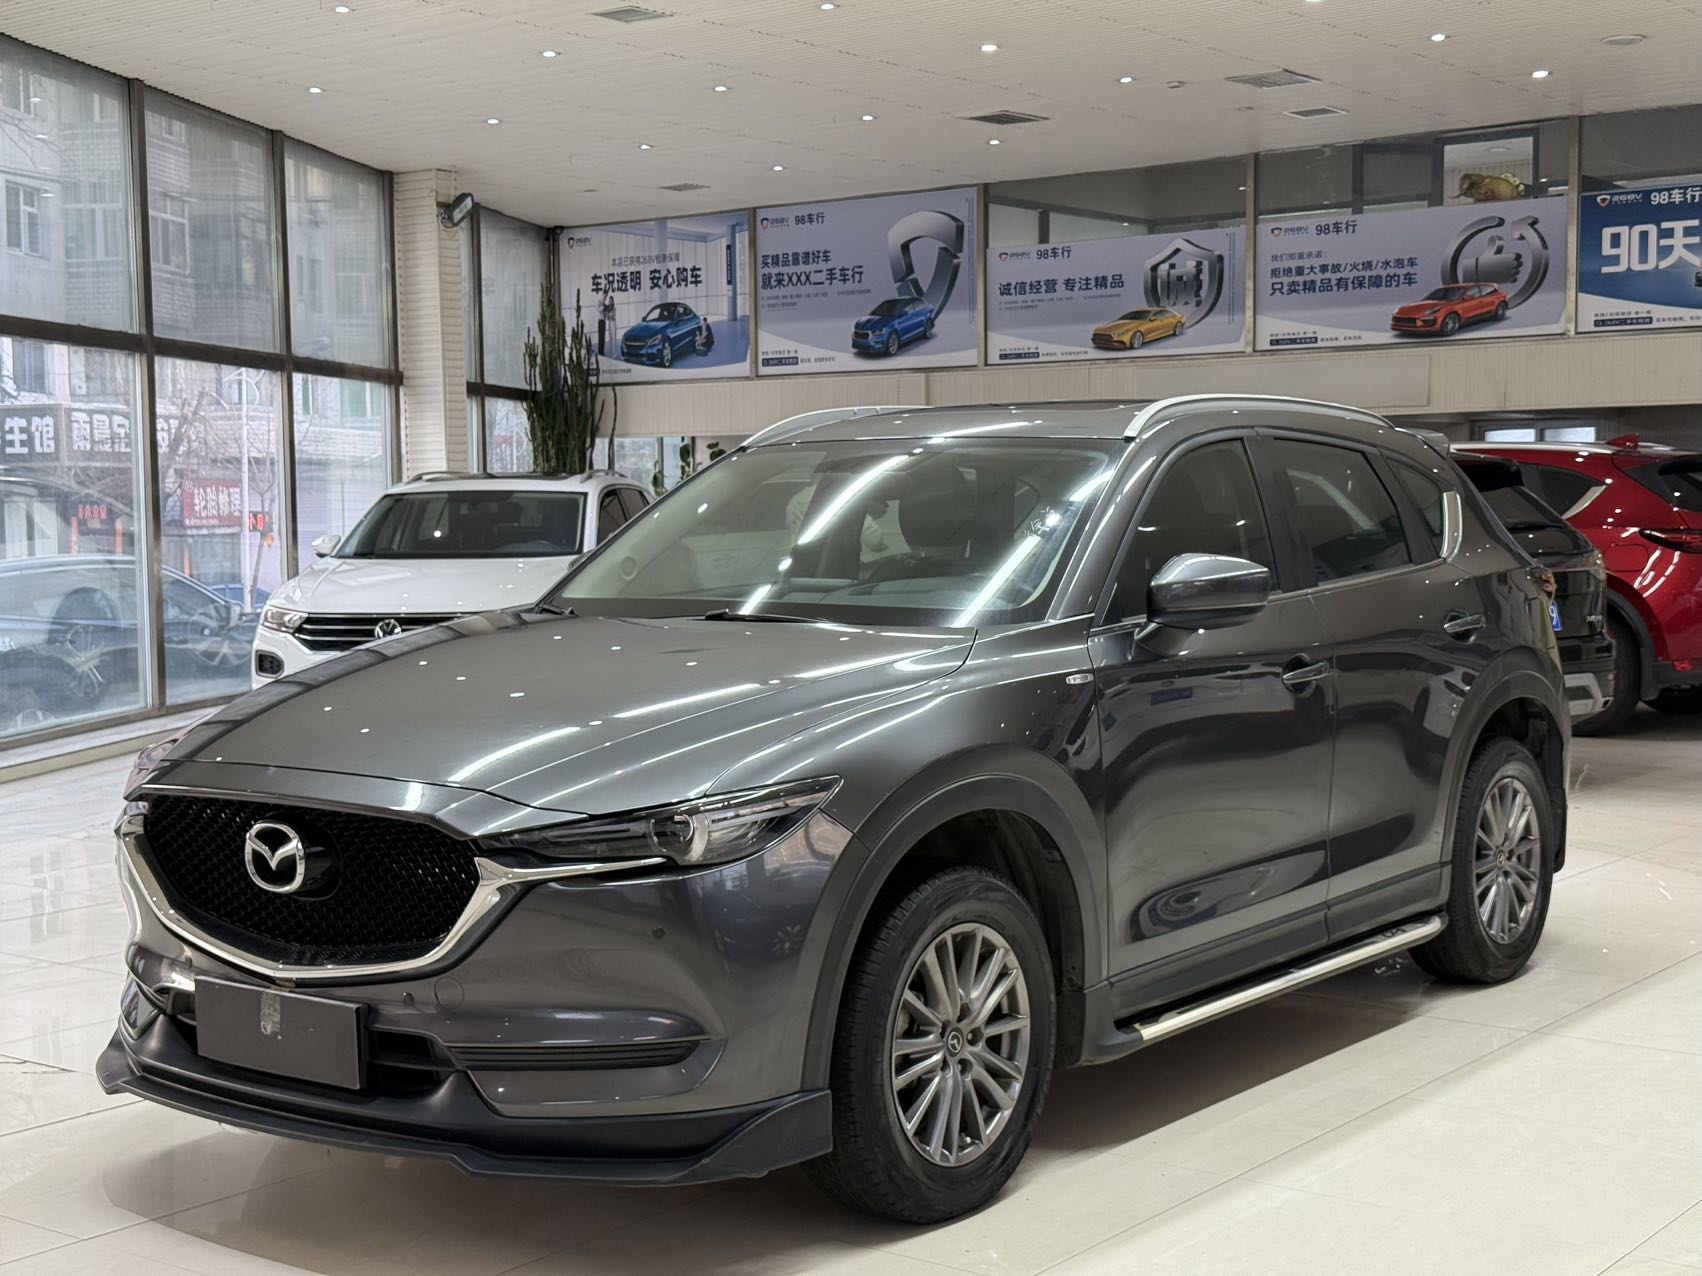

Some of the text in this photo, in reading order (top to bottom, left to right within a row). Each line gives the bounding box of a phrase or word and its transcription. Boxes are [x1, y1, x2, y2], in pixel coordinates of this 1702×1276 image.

[1650, 187, 1702, 205] 98车行
[794, 212, 825, 226] 98车行
[1315, 219, 1357, 236] 98车行
[1036, 246, 1072, 261] 98车行
[1601, 219, 1701, 273] 90天
[761, 250, 831, 270] 买精品靠谱好车
[1270, 257, 1418, 279] 拒绝重大事故/火烧/水泡车
[591, 271, 641, 294] 车况透明
[649, 265, 702, 290] 安心购车
[761, 265, 864, 290] 就来XXX二手车行
[998, 274, 1124, 297] 诚信经营 专注精品
[1270, 272, 1418, 297] 只卖精品有保障的车
